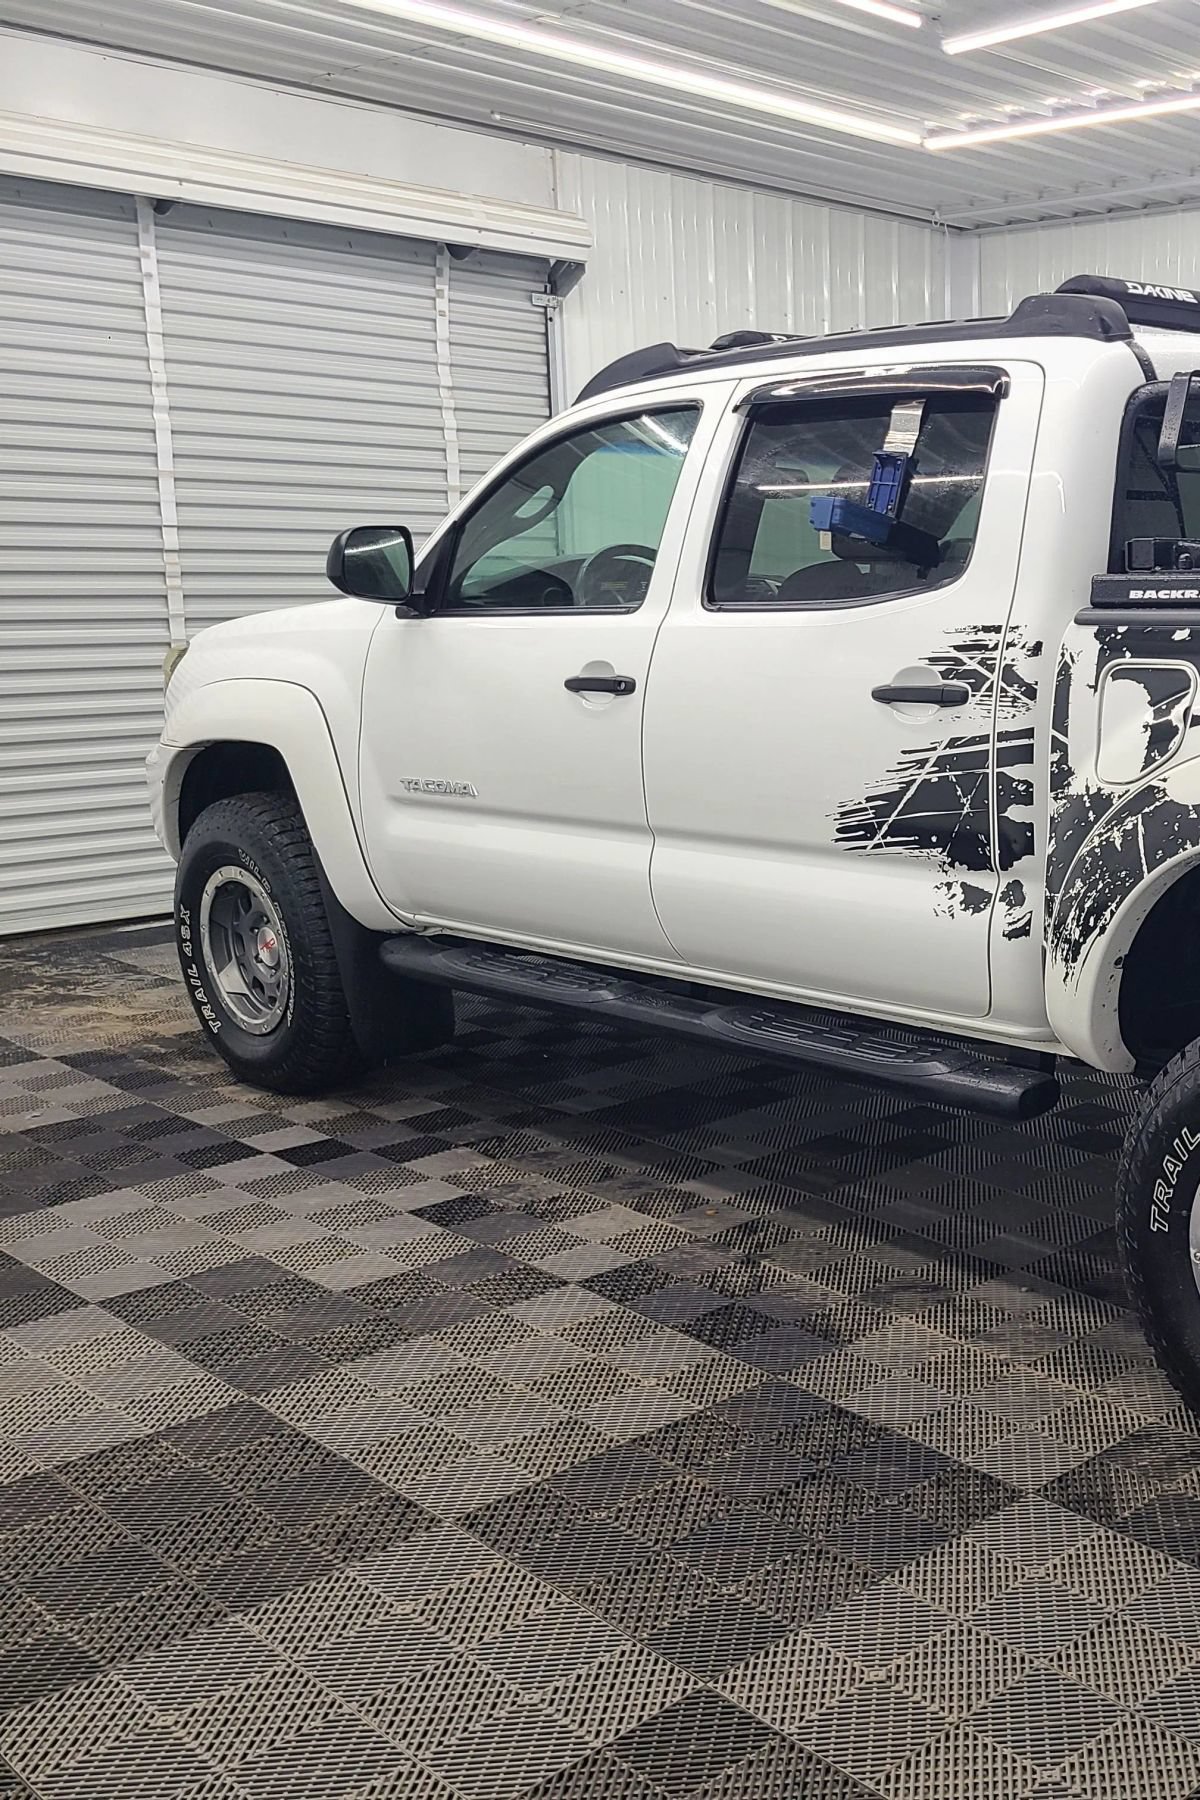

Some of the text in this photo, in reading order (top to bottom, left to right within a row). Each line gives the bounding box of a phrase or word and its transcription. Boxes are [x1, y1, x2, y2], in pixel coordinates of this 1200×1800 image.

[1125, 281, 1199, 304] DAKINE
[400, 776, 480, 798] TACOMA
[179, 904, 223, 1035] TRAIL 4SX
